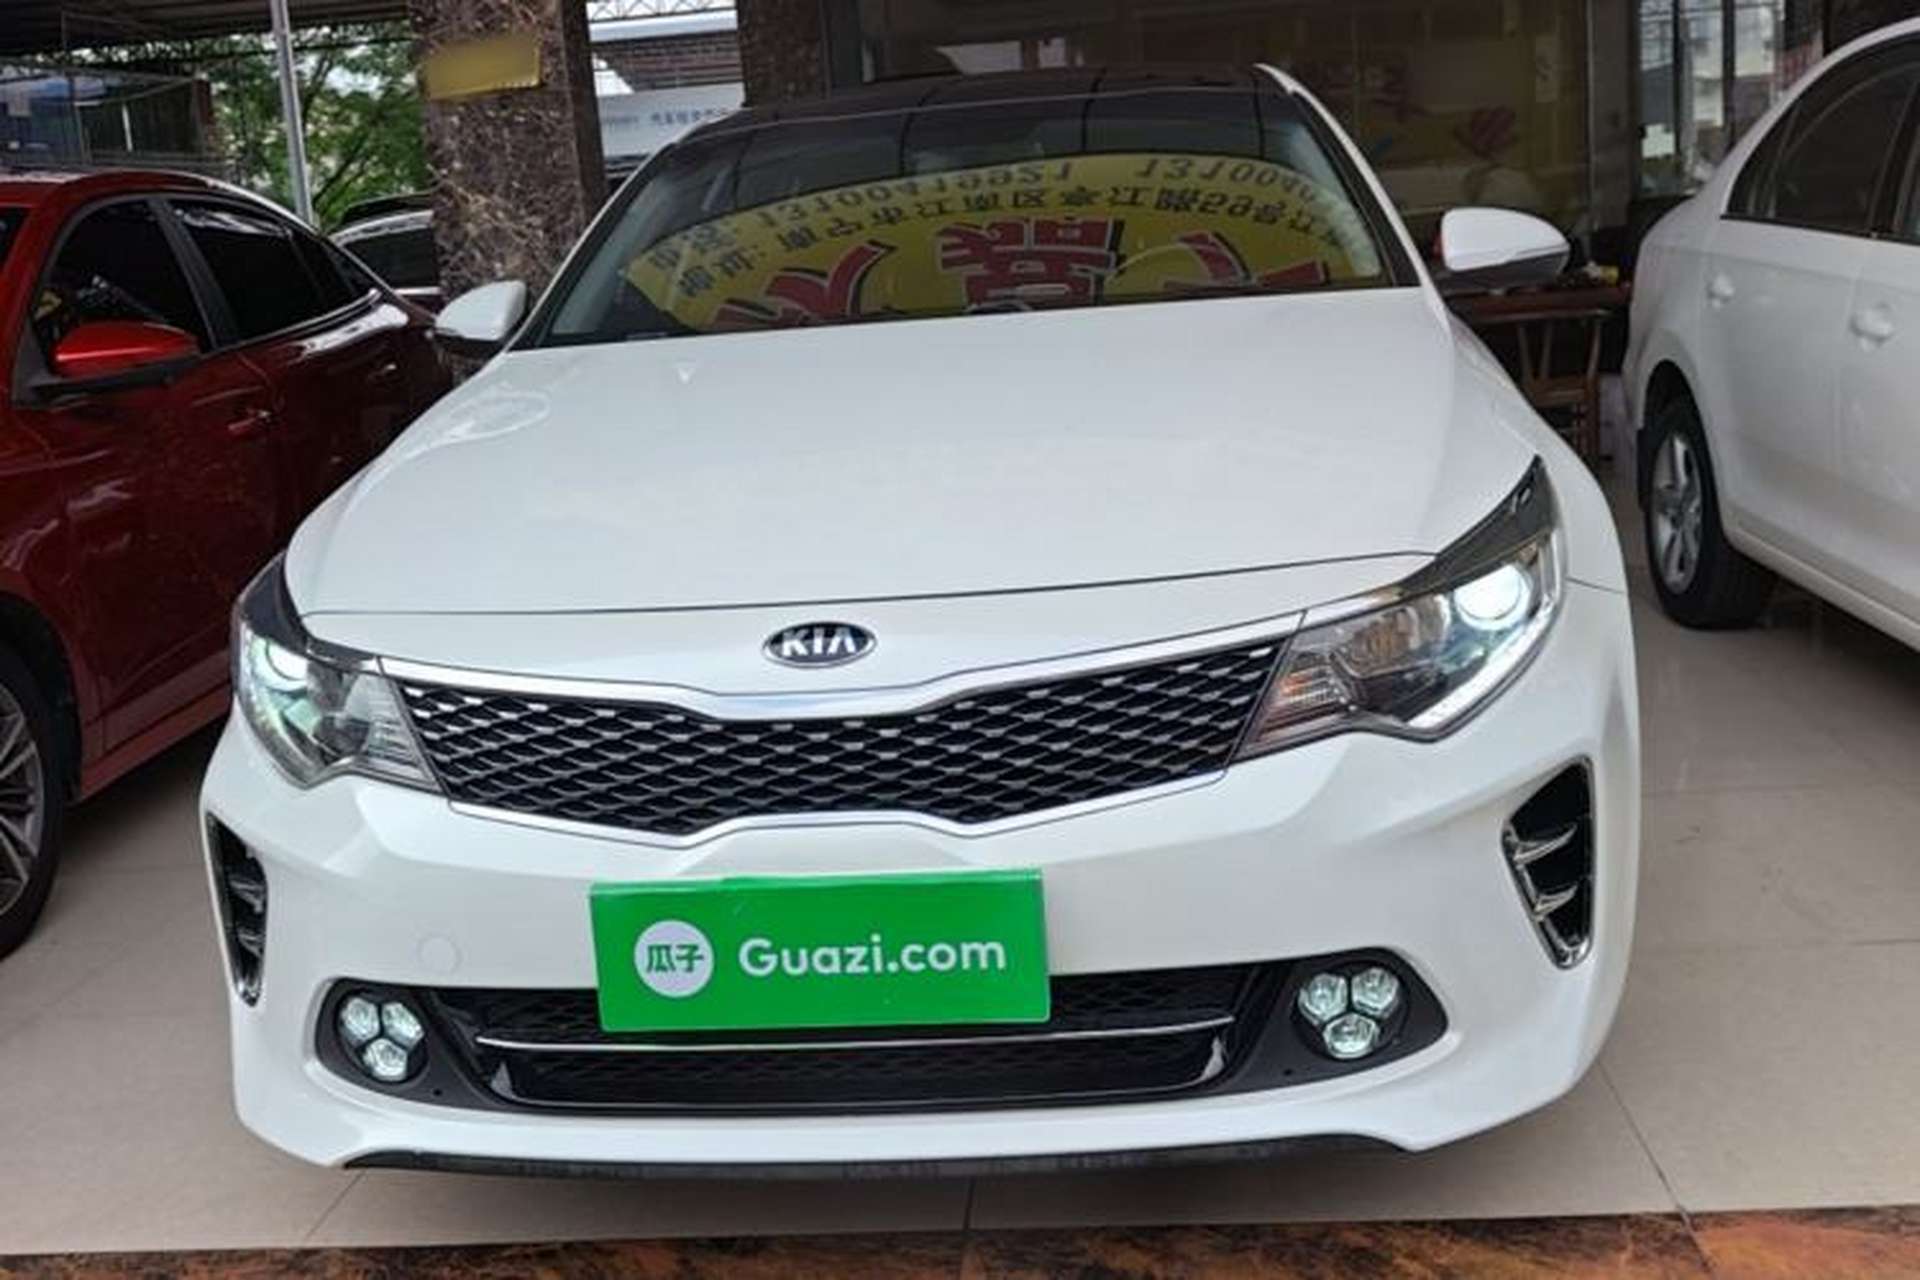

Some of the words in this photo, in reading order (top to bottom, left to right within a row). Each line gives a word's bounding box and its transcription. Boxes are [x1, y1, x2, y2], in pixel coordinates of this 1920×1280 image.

[782, 627, 857, 656] KIA
[645, 942, 705, 975] 瓜子
[738, 934, 1007, 977] Guazi.com
